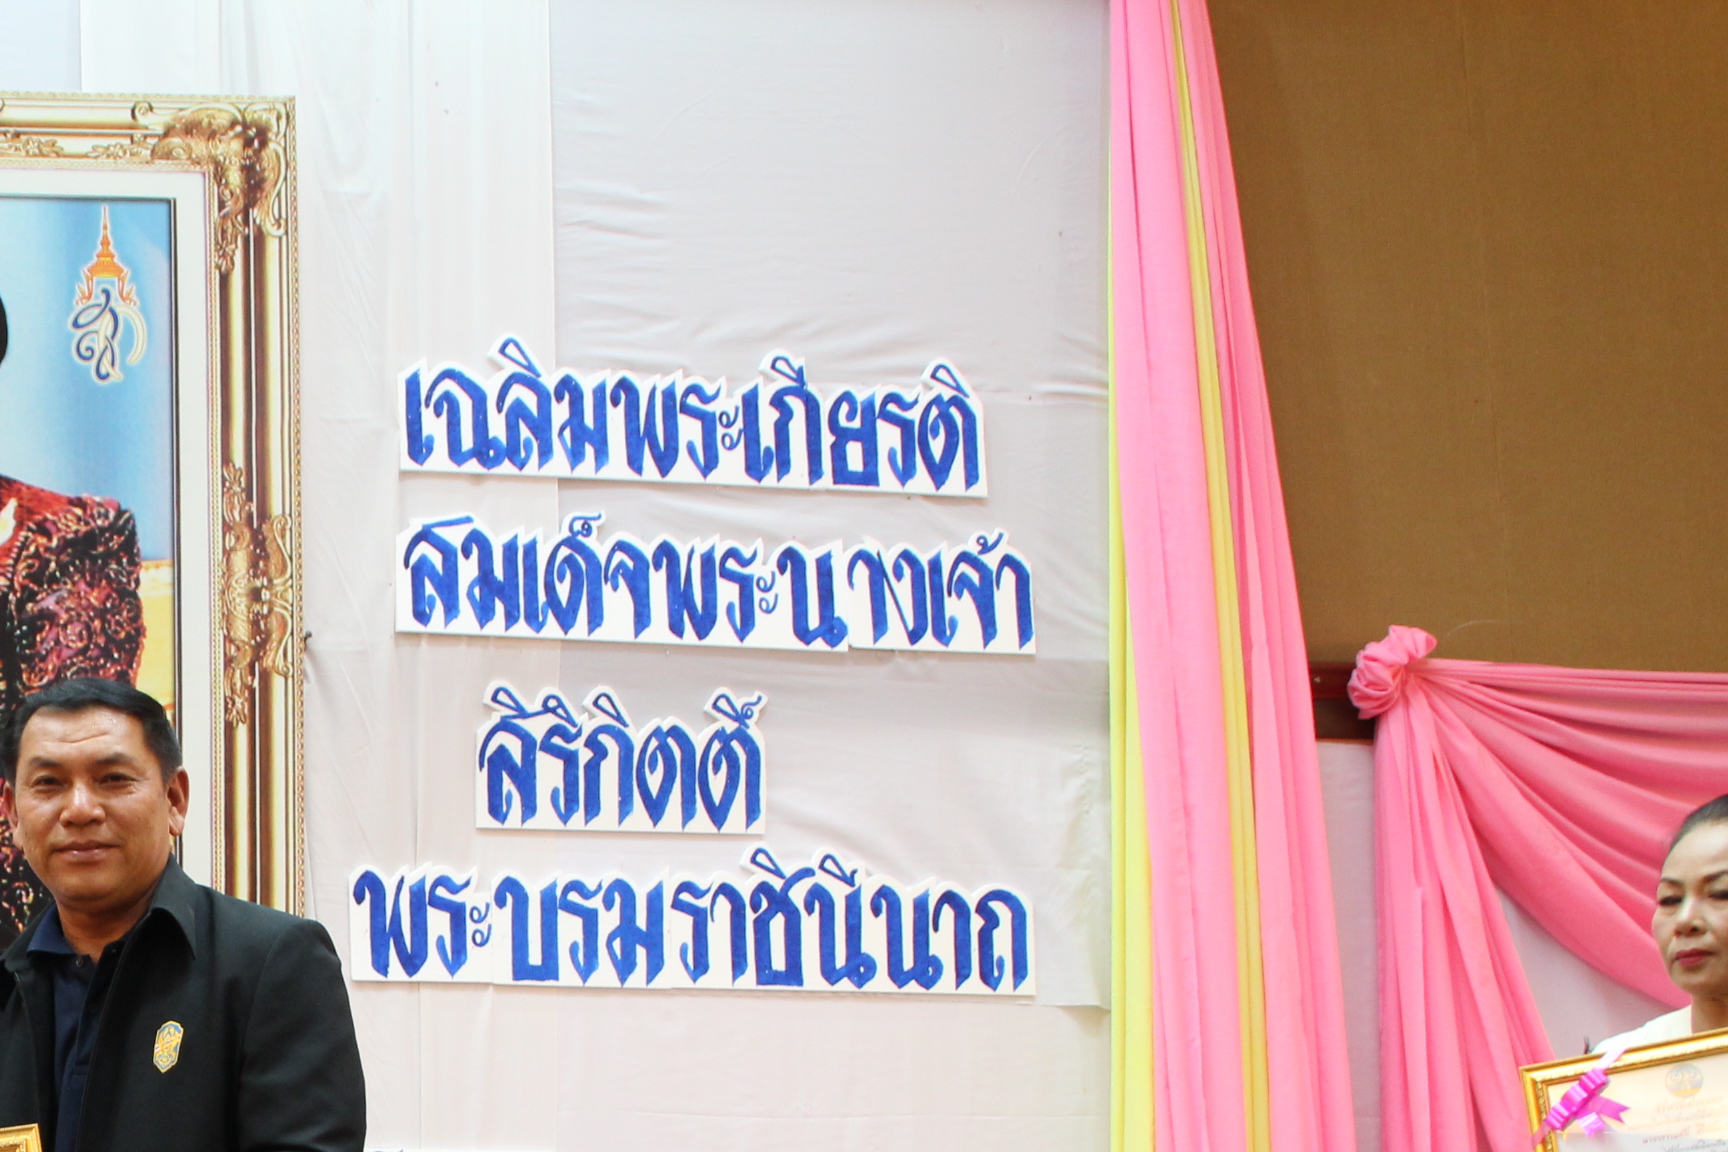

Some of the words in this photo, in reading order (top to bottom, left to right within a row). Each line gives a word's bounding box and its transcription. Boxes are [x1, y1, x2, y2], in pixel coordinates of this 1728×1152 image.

[405, 337, 980, 491] เฉลิมพระเกียรติ
[404, 514, 1035, 649] สมเด็จพระนางเจ้า
[353, 847, 1029, 992] พระบรมราชินีนาถ
